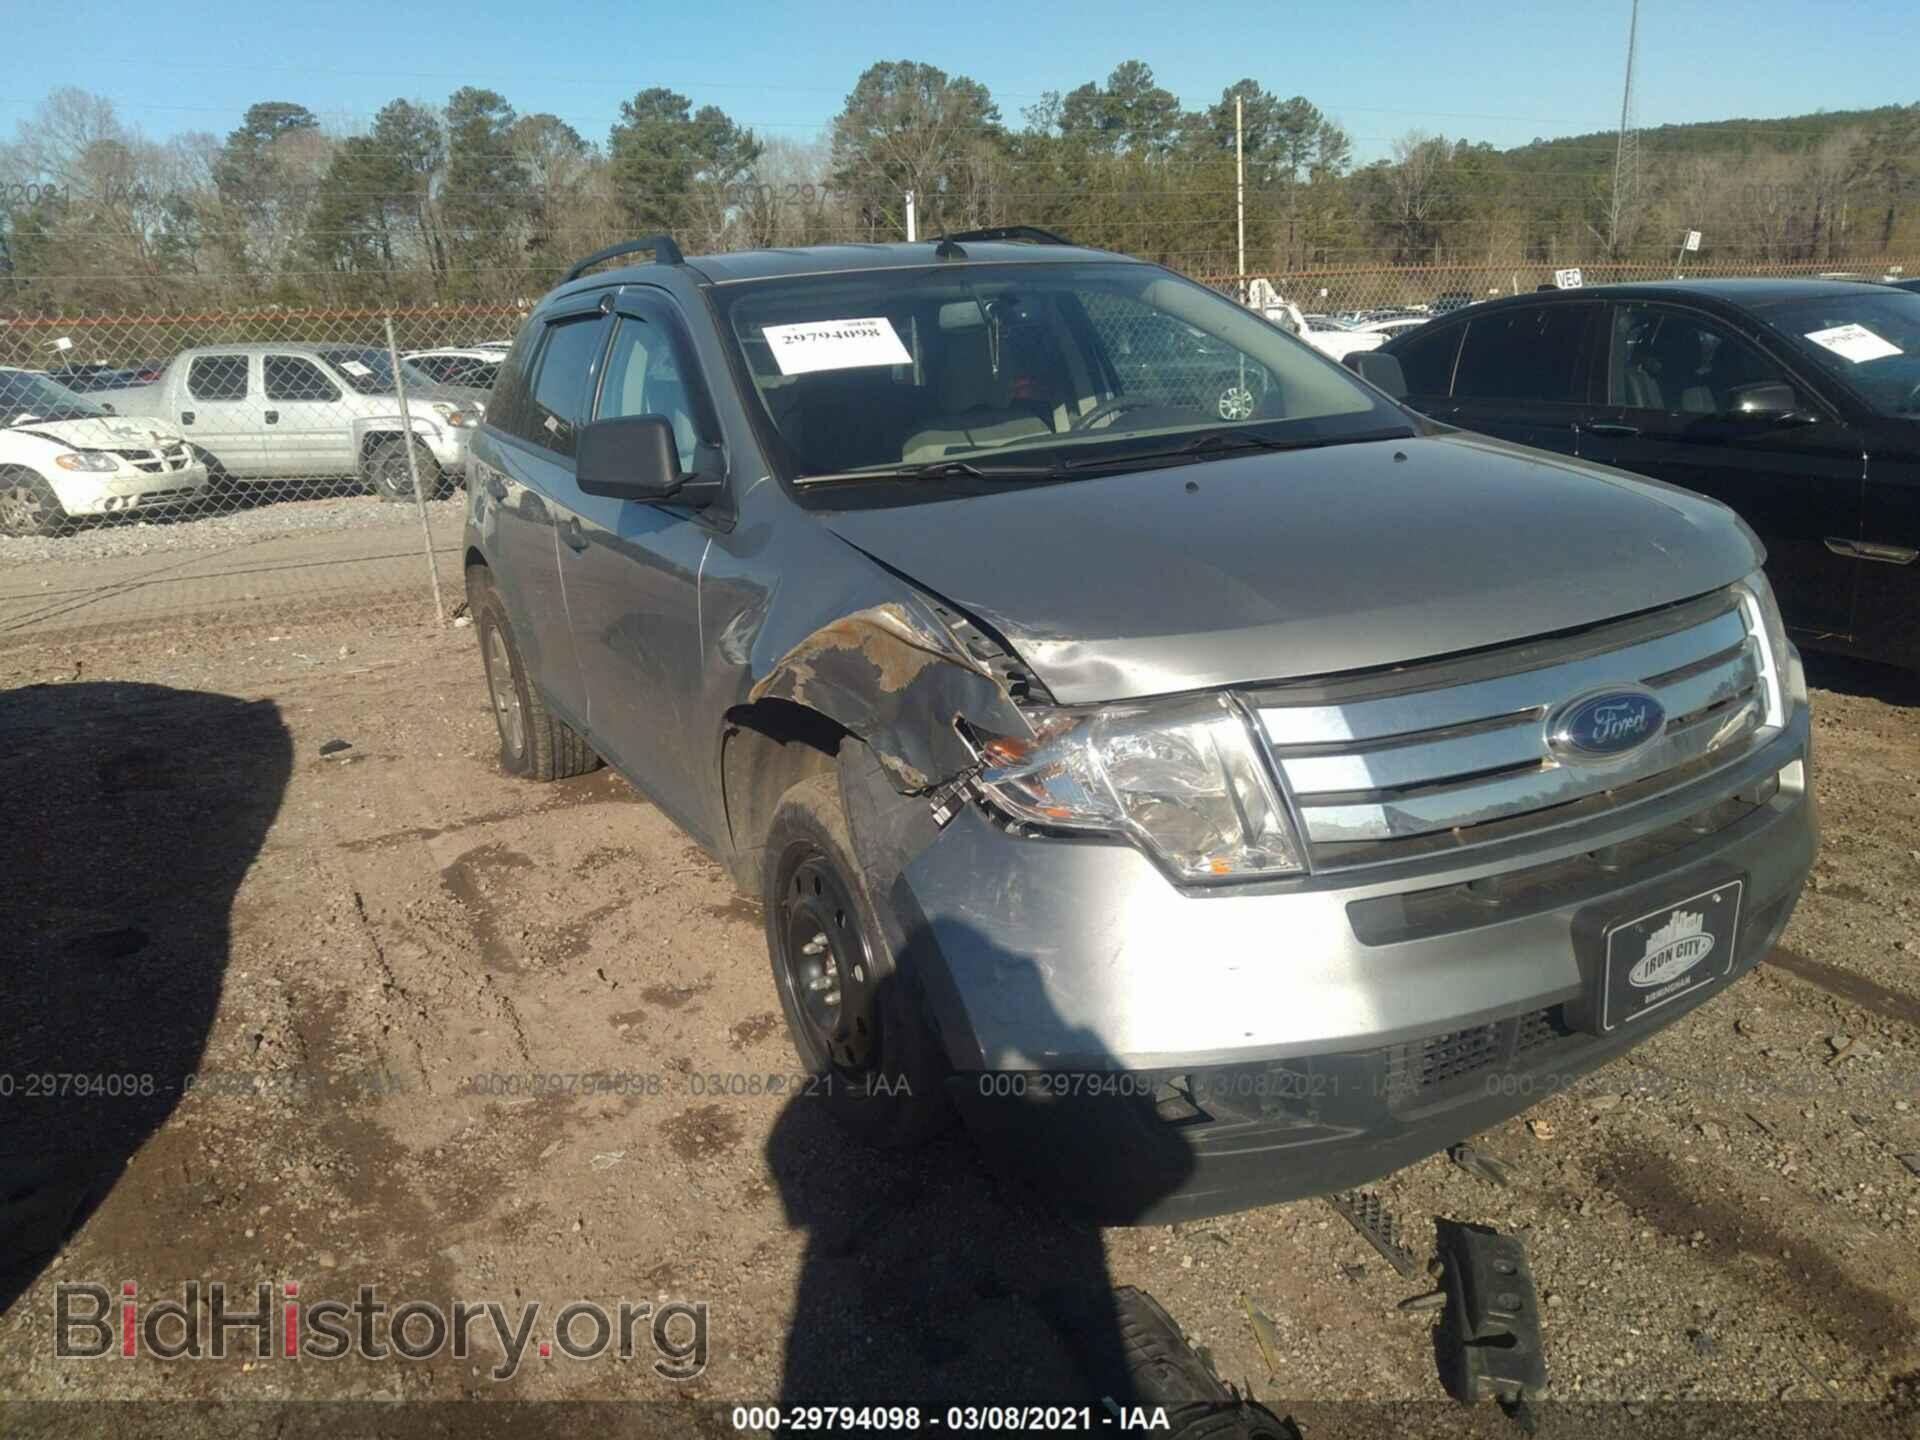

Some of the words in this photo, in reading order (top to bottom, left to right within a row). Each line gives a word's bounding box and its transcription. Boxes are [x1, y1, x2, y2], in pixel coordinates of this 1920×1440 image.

[1558, 270, 1581, 287] VEC
[782, 328, 880, 345] 29794098
[1592, 702, 1646, 744] Ford
[1644, 946, 1673, 977] IRON
[1675, 938, 1700, 958] CITY
